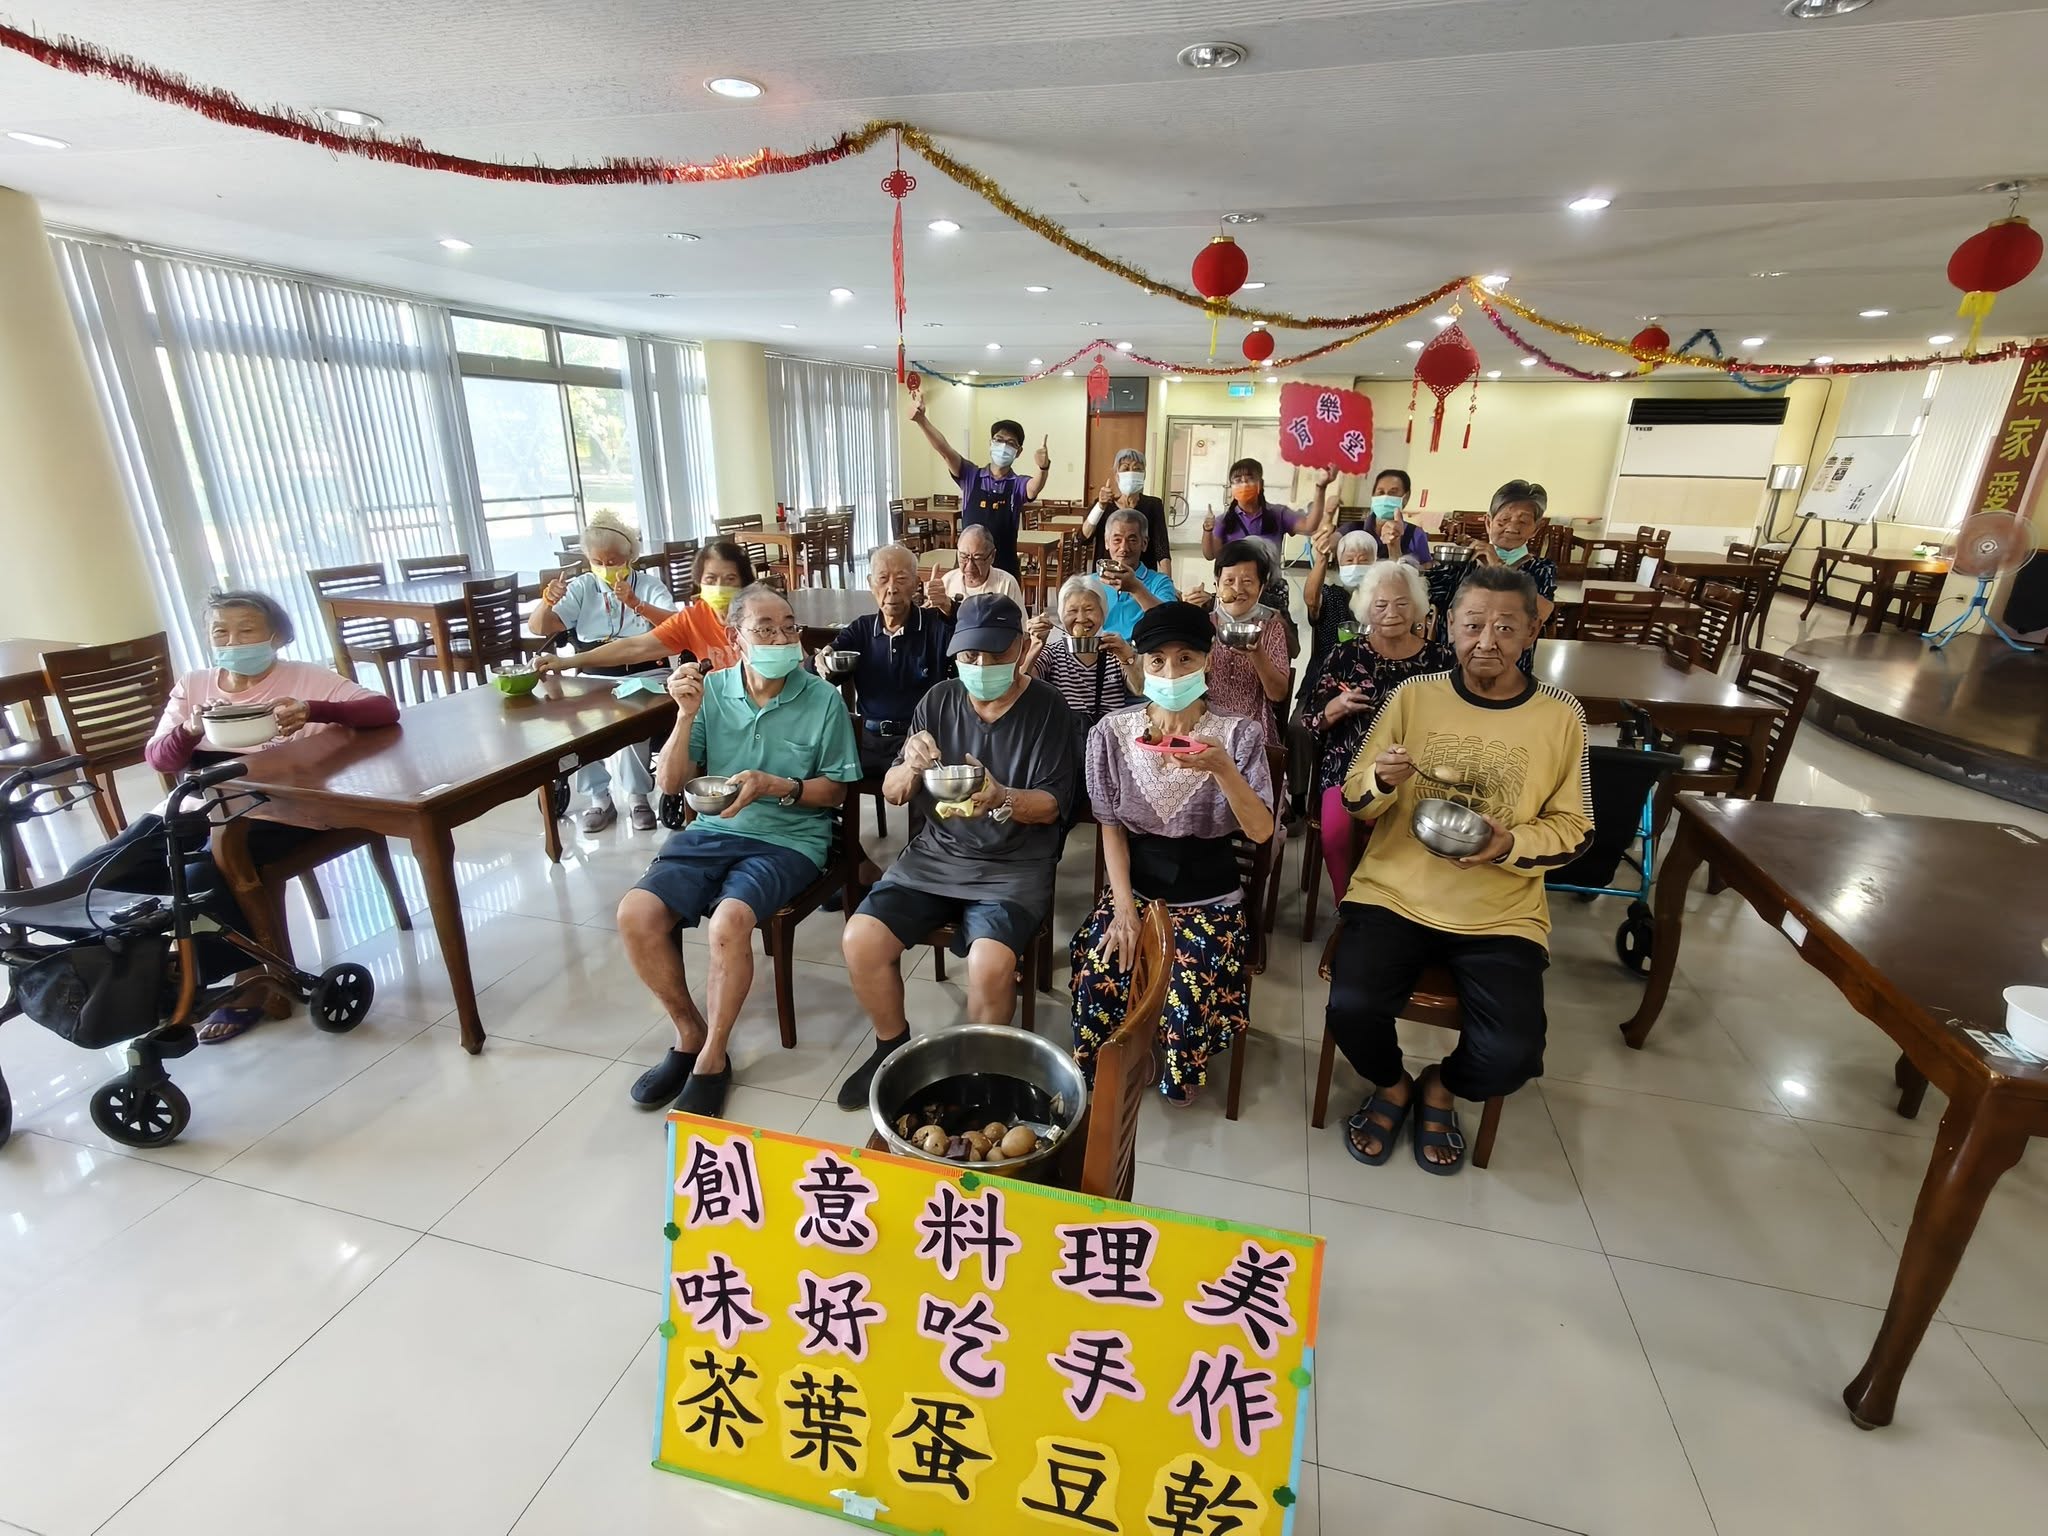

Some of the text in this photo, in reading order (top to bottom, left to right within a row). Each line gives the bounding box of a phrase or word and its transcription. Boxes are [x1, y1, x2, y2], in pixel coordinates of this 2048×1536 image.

[682, 1141, 1290, 1351] 創意料理美
[677, 1256, 1274, 1447] 味好吃手作
[677, 1350, 1258, 1536] 茶葉蛋豆乾
